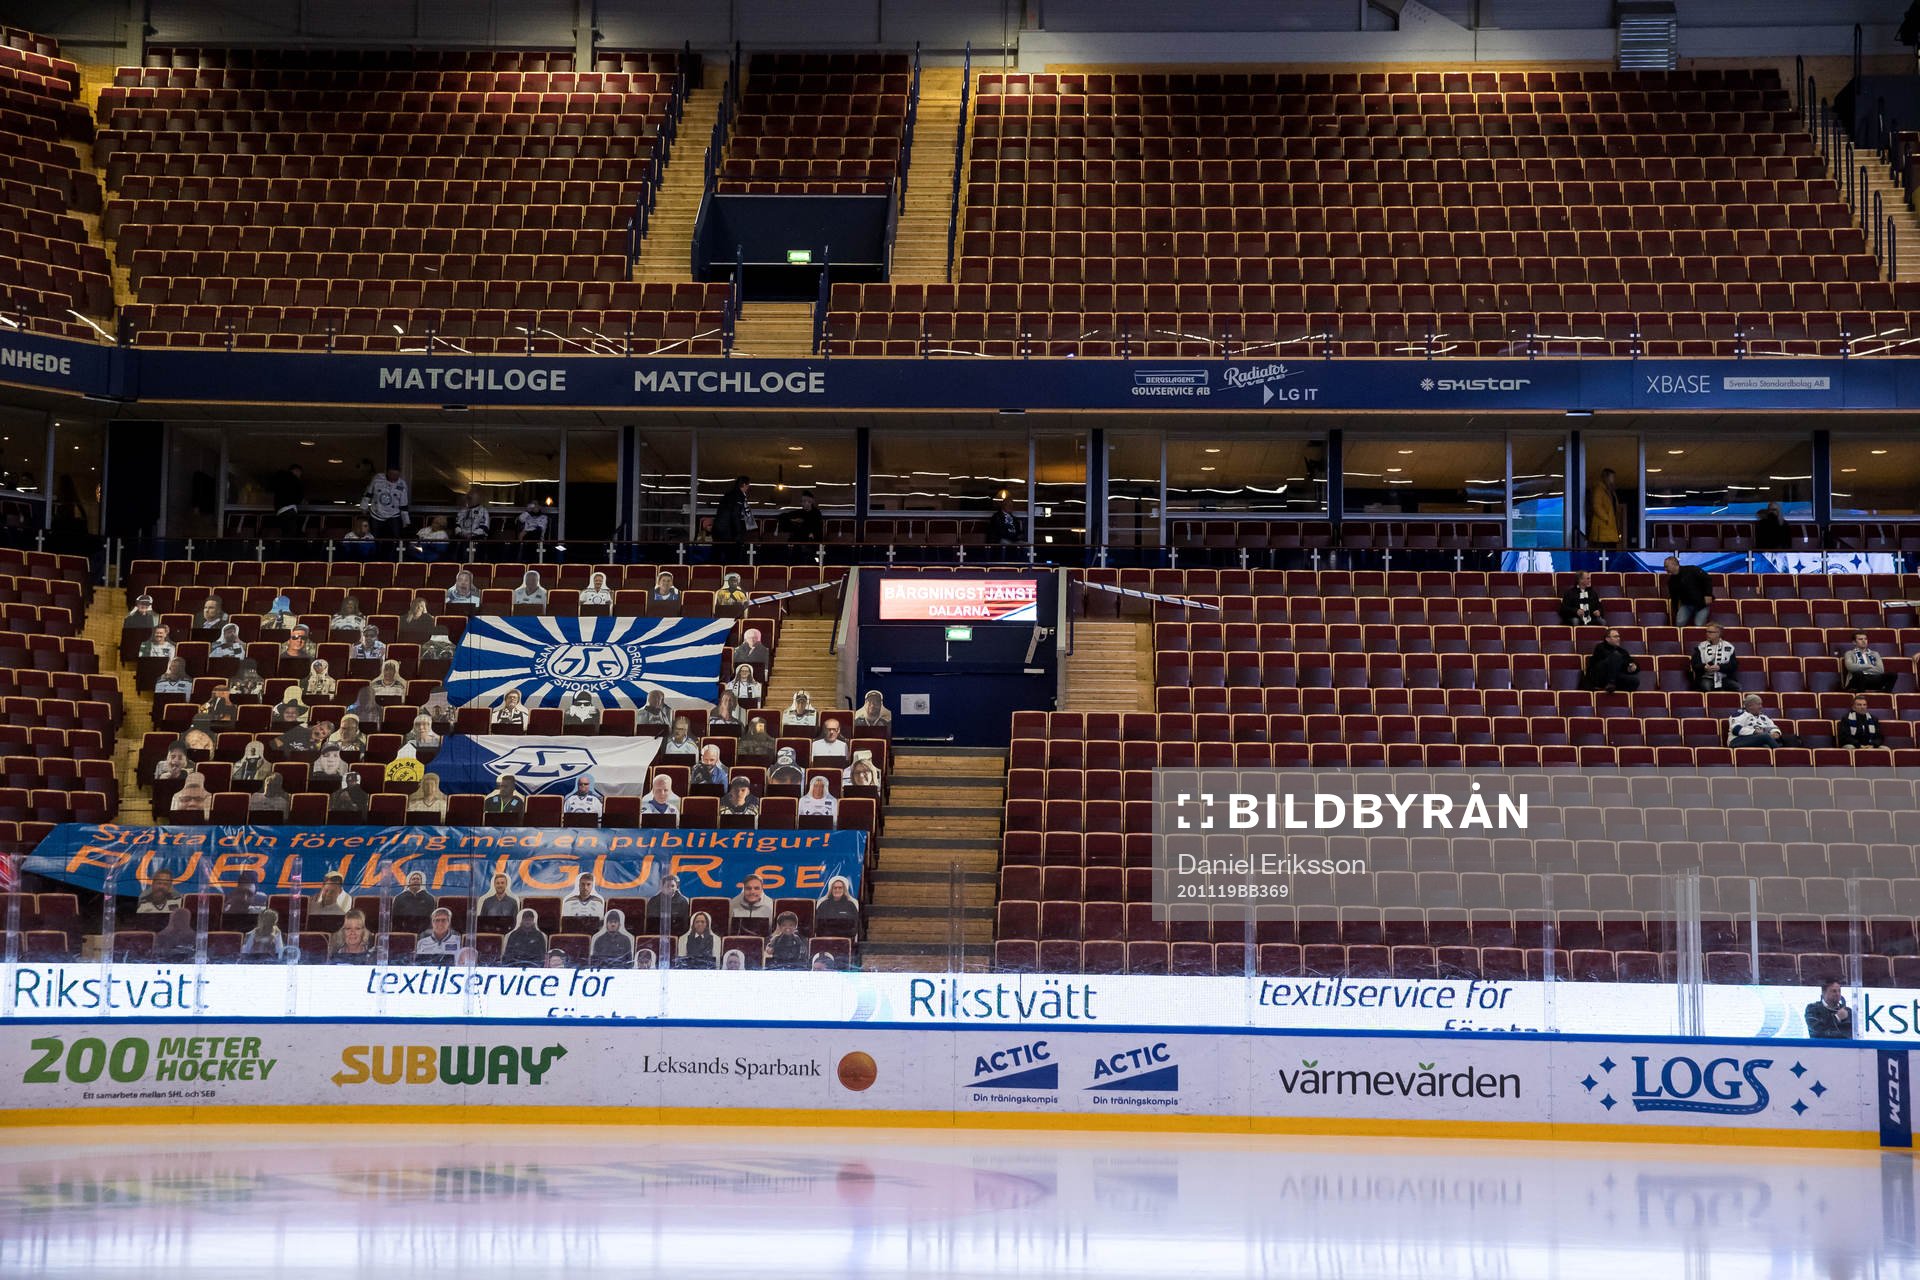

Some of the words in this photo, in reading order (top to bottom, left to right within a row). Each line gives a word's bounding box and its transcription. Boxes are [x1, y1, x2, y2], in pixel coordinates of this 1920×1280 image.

[379, 368, 566, 391] MATCHLOGE
[634, 371, 825, 393] MATCHLOGE
[1223, 363, 1288, 388] Radiator
[1646, 375, 1711, 393] XBASE
[1728, 380, 1758, 388] Svenska
[1759, 379, 1812, 389] Standardbolag
[1814, 379, 1825, 387] AB
[1131, 386, 1193, 396] GOLVSERVICE
[1197, 386, 1211, 396] AB
[1279, 388, 1300, 401] LG
[1305, 388, 1319, 401] IT
[928, 605, 990, 617] DALARNA
[92, 823, 207, 845] Stötta
[218, 832, 278, 847] din
[289, 832, 450, 851] förening
[459, 831, 543, 847] med
[554, 835, 598, 847] en
[610, 831, 831, 852] publikfigur!
[14, 968, 210, 1009] Rikstvätt
[367, 966, 559, 997] textilservice
[568, 966, 615, 997] för
[1259, 977, 1455, 1009] textilservice
[1465, 979, 1513, 1009] för
[910, 978, 1097, 1019] Rikstvätt
[156, 1036, 262, 1058] METER
[974, 1040, 1050, 1077] ACTIC
[22, 1037, 150, 1084] 200
[155, 1059, 277, 1082] HOCKEY
[330, 1042, 569, 1087] SUBWAY
[643, 1055, 729, 1075] Leksands
[734, 1057, 821, 1079] Sparbank
[1094, 1042, 1171, 1079] ACTIC
[1631, 1056, 1774, 1103] LOGS
[1888, 1058, 1901, 1125] CCM
[82, 1091, 94, 1099] Ett
[96, 1091, 138, 1099] samarbete
[139, 1090, 167, 1098] mellan
[168, 1090, 183, 1098] SHL
[184, 1090, 200, 1098] och
[200, 1090, 216, 1098] SEB
[973, 1093, 988, 1102] Din
[990, 1093, 1058, 1105] träningskompis
[1093, 1096, 1108, 1105] Din
[1110, 1096, 1179, 1107] träningskompis
